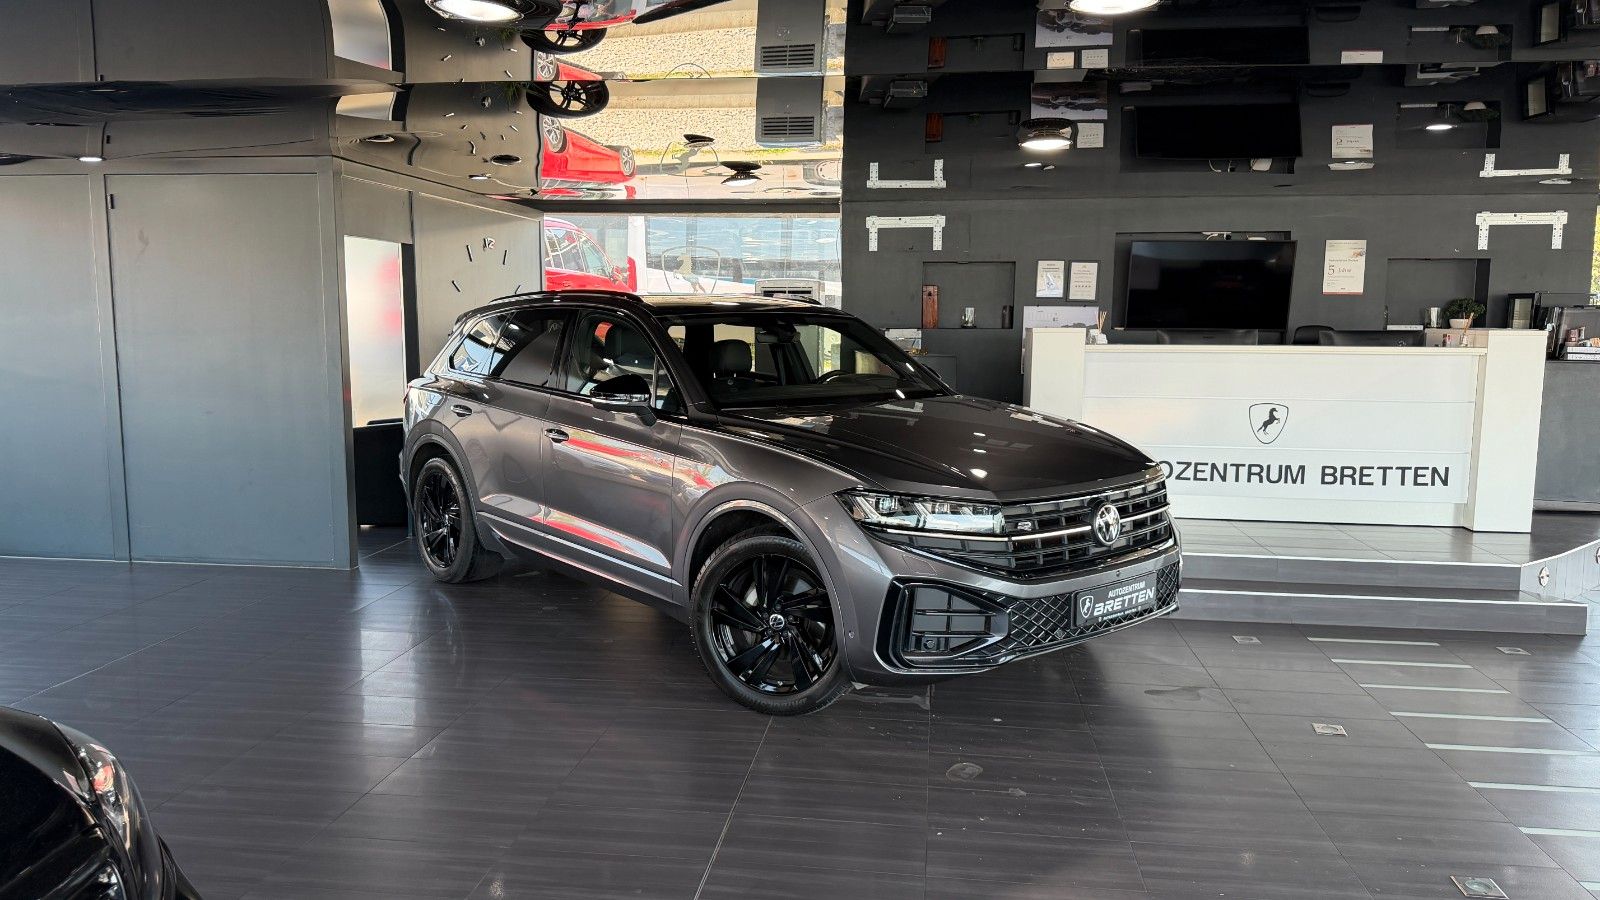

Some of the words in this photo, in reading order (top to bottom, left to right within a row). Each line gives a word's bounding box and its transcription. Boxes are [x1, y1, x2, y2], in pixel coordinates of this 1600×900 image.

[1320, 465, 1449, 487] BRETTEN
[1108, 581, 1146, 598] AUTOZENTRUM
[1093, 587, 1155, 616] BRETTEN
